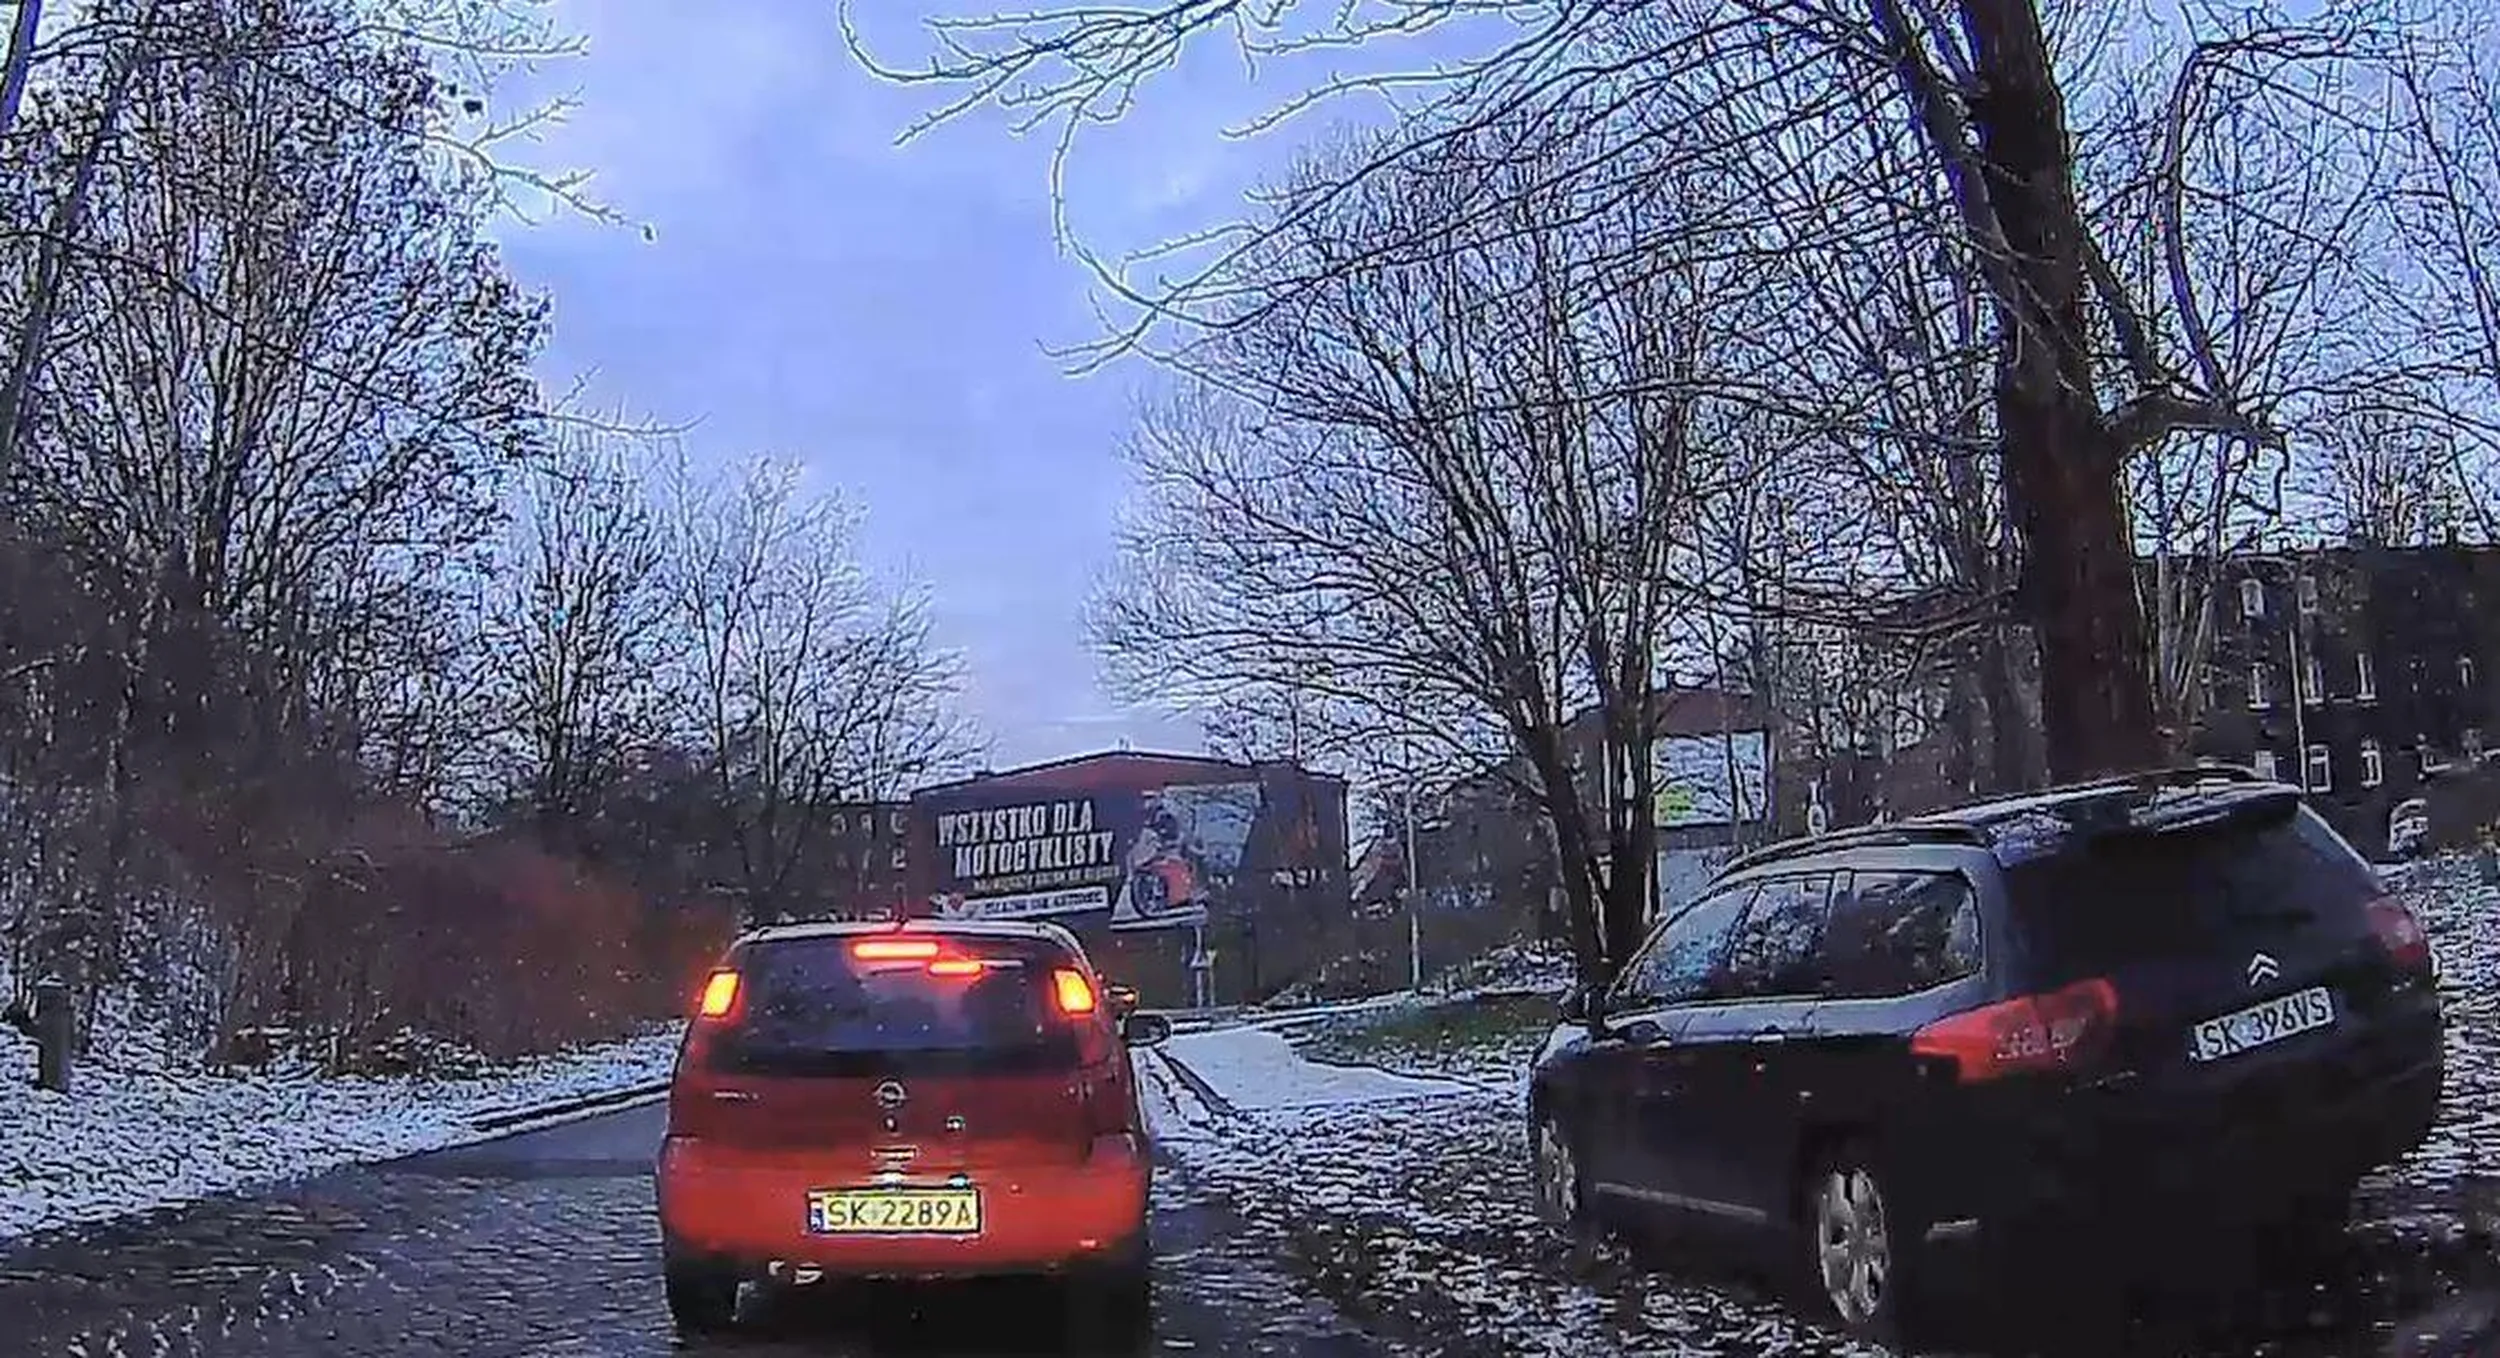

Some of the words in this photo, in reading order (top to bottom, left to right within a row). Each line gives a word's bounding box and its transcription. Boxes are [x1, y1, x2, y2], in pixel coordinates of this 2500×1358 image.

[938, 805, 1046, 846] WSZYSTKO
[1053, 800, 1093, 834] DLA
[955, 830, 1114, 878] MOTOCYKLISTY
[2203, 1019, 2244, 1056] SK
[2249, 992, 2327, 1042] 396VS
[828, 1200, 868, 1226] SK
[882, 1200, 973, 1226] 2289A
